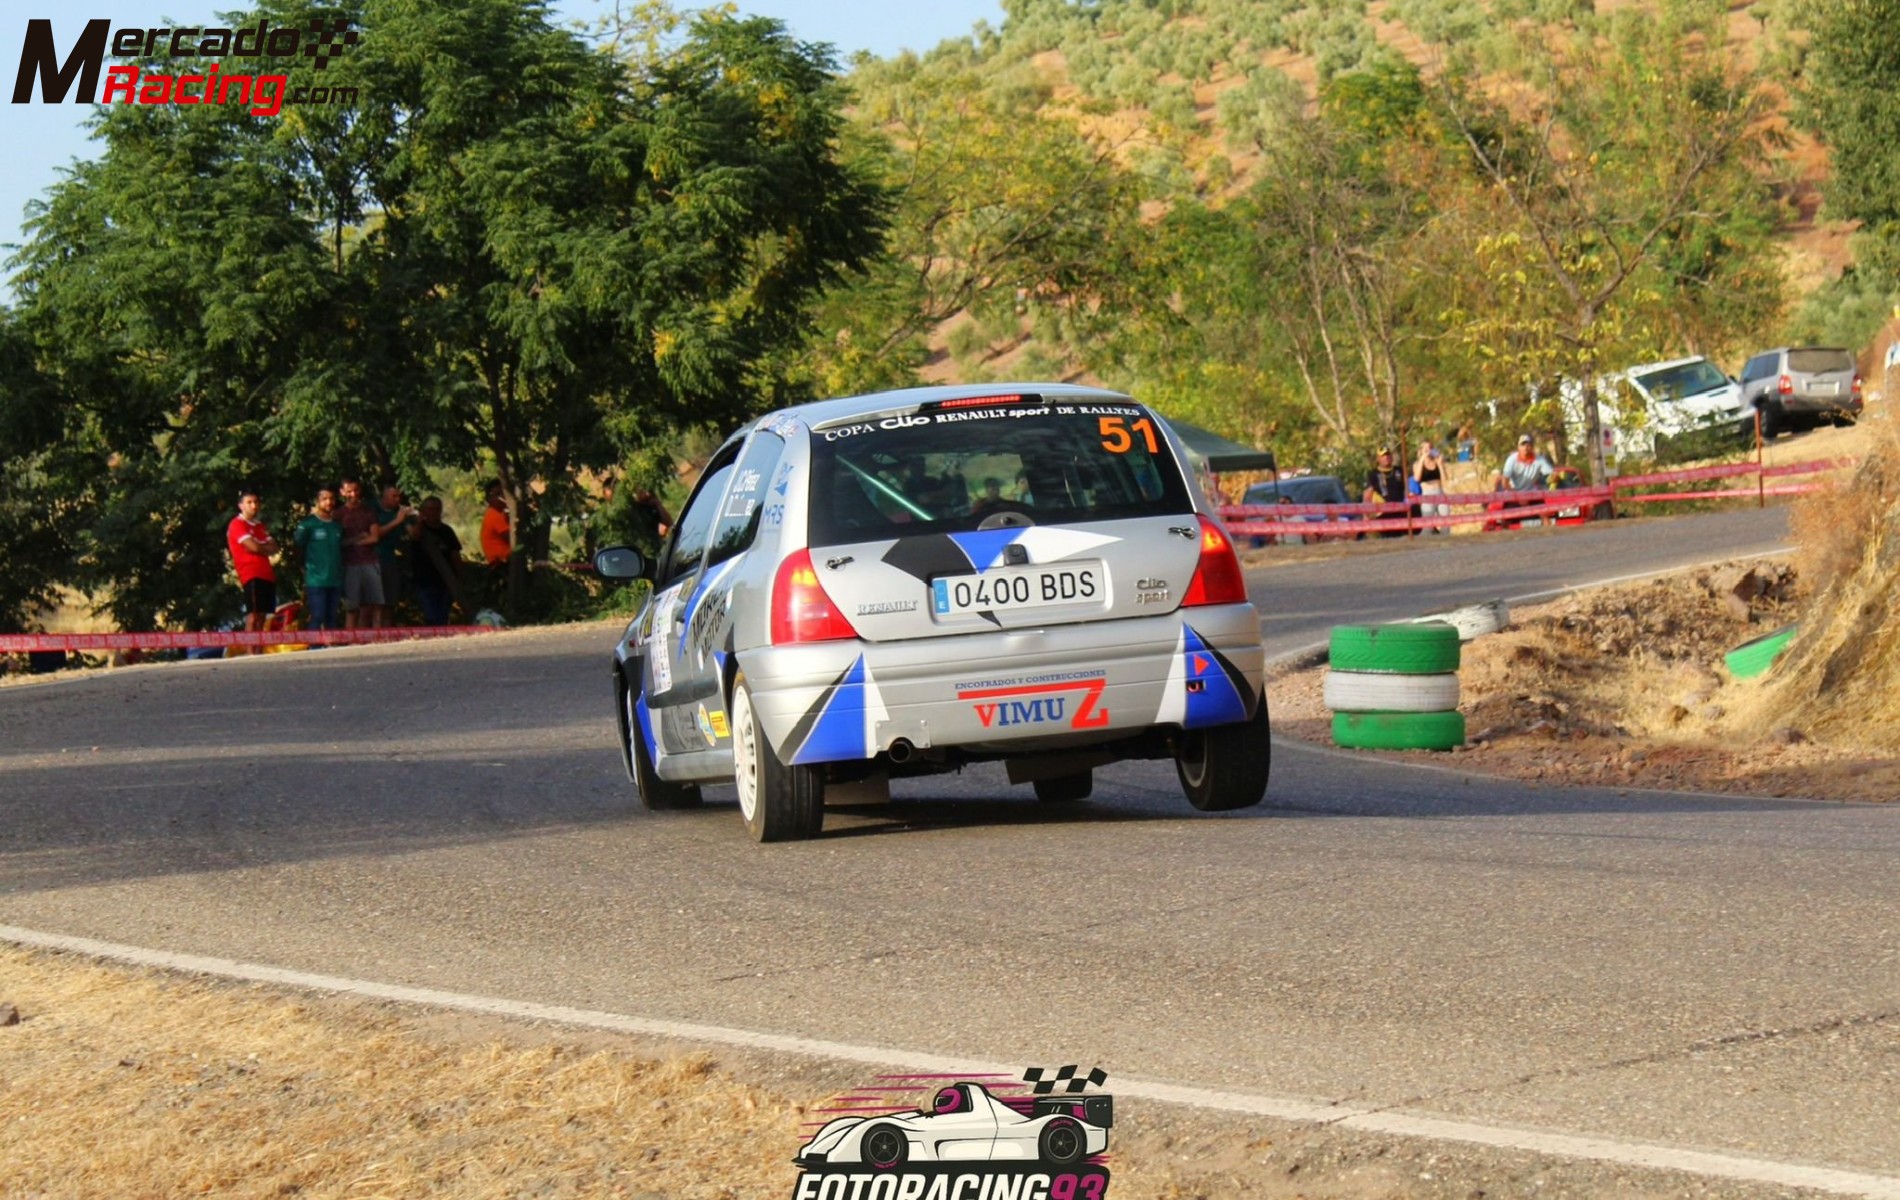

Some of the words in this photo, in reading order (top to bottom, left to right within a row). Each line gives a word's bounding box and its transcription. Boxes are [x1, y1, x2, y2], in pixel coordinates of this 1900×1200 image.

[824, 423, 875, 442] COPA
[879, 414, 931, 430] Clio
[935, 407, 1006, 424] RENAULT
[1009, 406, 1050, 418] sport
[1056, 406, 1075, 415] DE
[1079, 406, 1141, 416] RALLYES
[1099, 416, 1159, 454] 51
[954, 575, 1030, 609] 0400
[1041, 570, 1096, 602] BDS
[1136, 577, 1167, 590] Clio
[857, 600, 918, 616] RENAULT
[954, 678, 1017, 690] ENCOFRADOS
[1026, 669, 1107, 684] CONSTRUCCIONES
